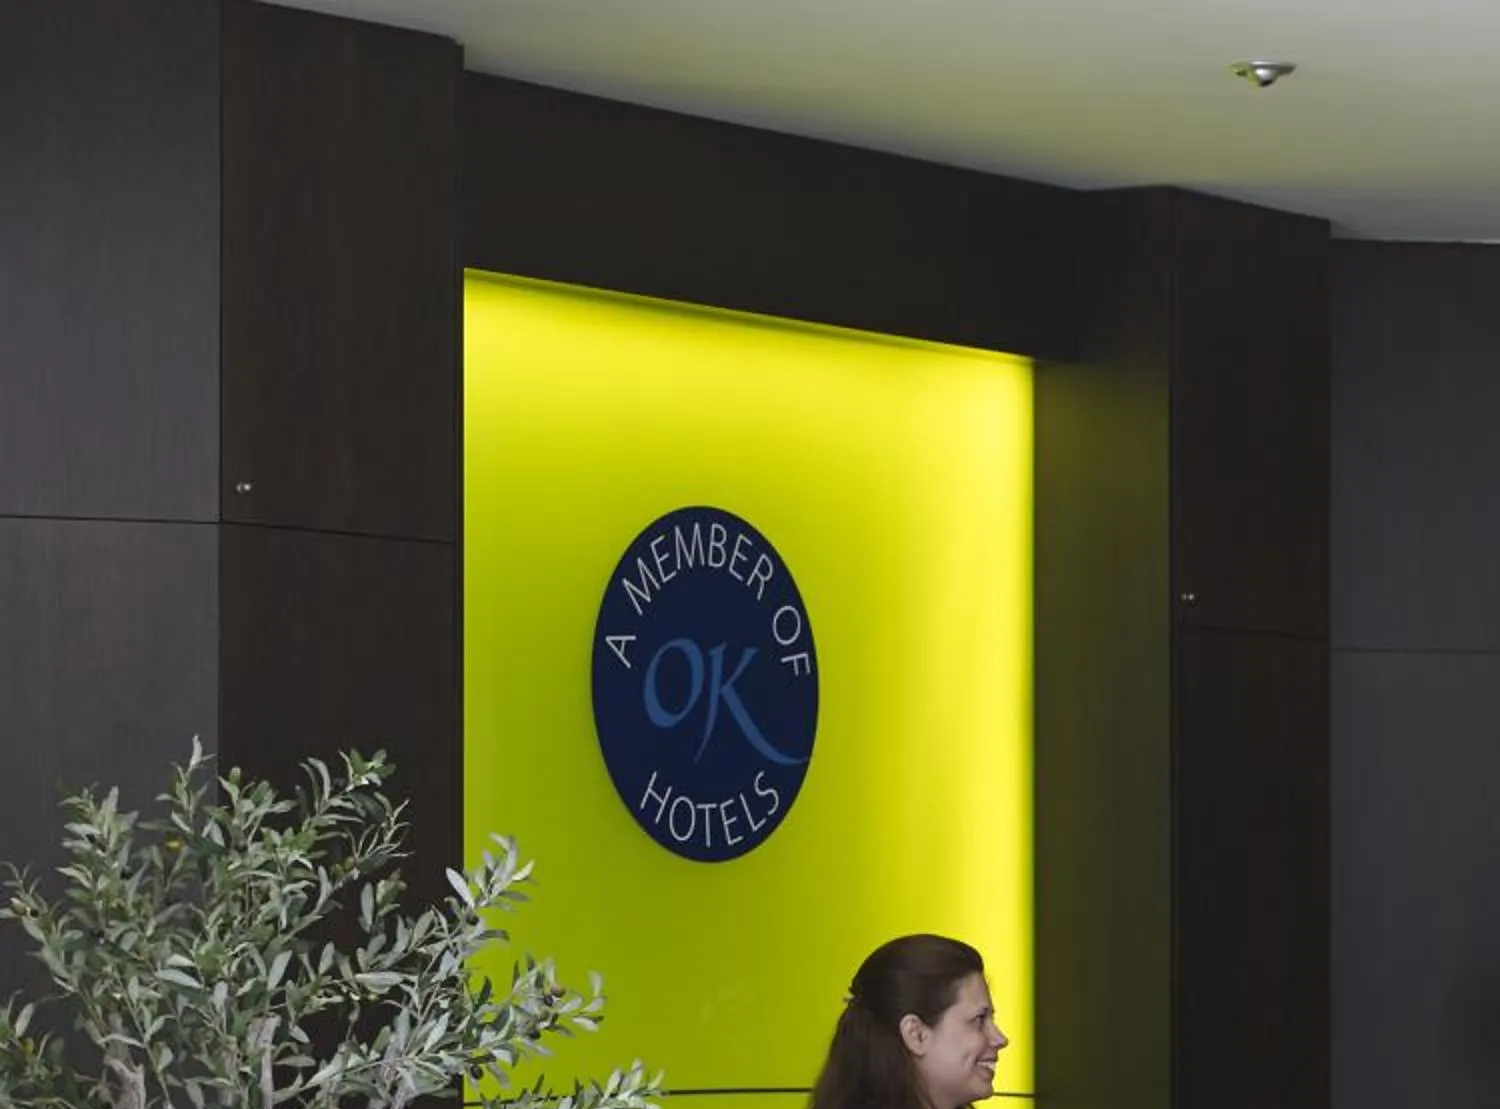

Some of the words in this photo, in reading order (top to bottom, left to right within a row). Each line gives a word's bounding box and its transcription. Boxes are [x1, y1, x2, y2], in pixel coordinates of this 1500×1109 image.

[605, 634, 637, 669] A
[621, 522, 774, 616] MEMBER
[772, 605, 811, 676] OF
[643, 637, 809, 766] OK
[640, 771, 780, 848] HOTELS
